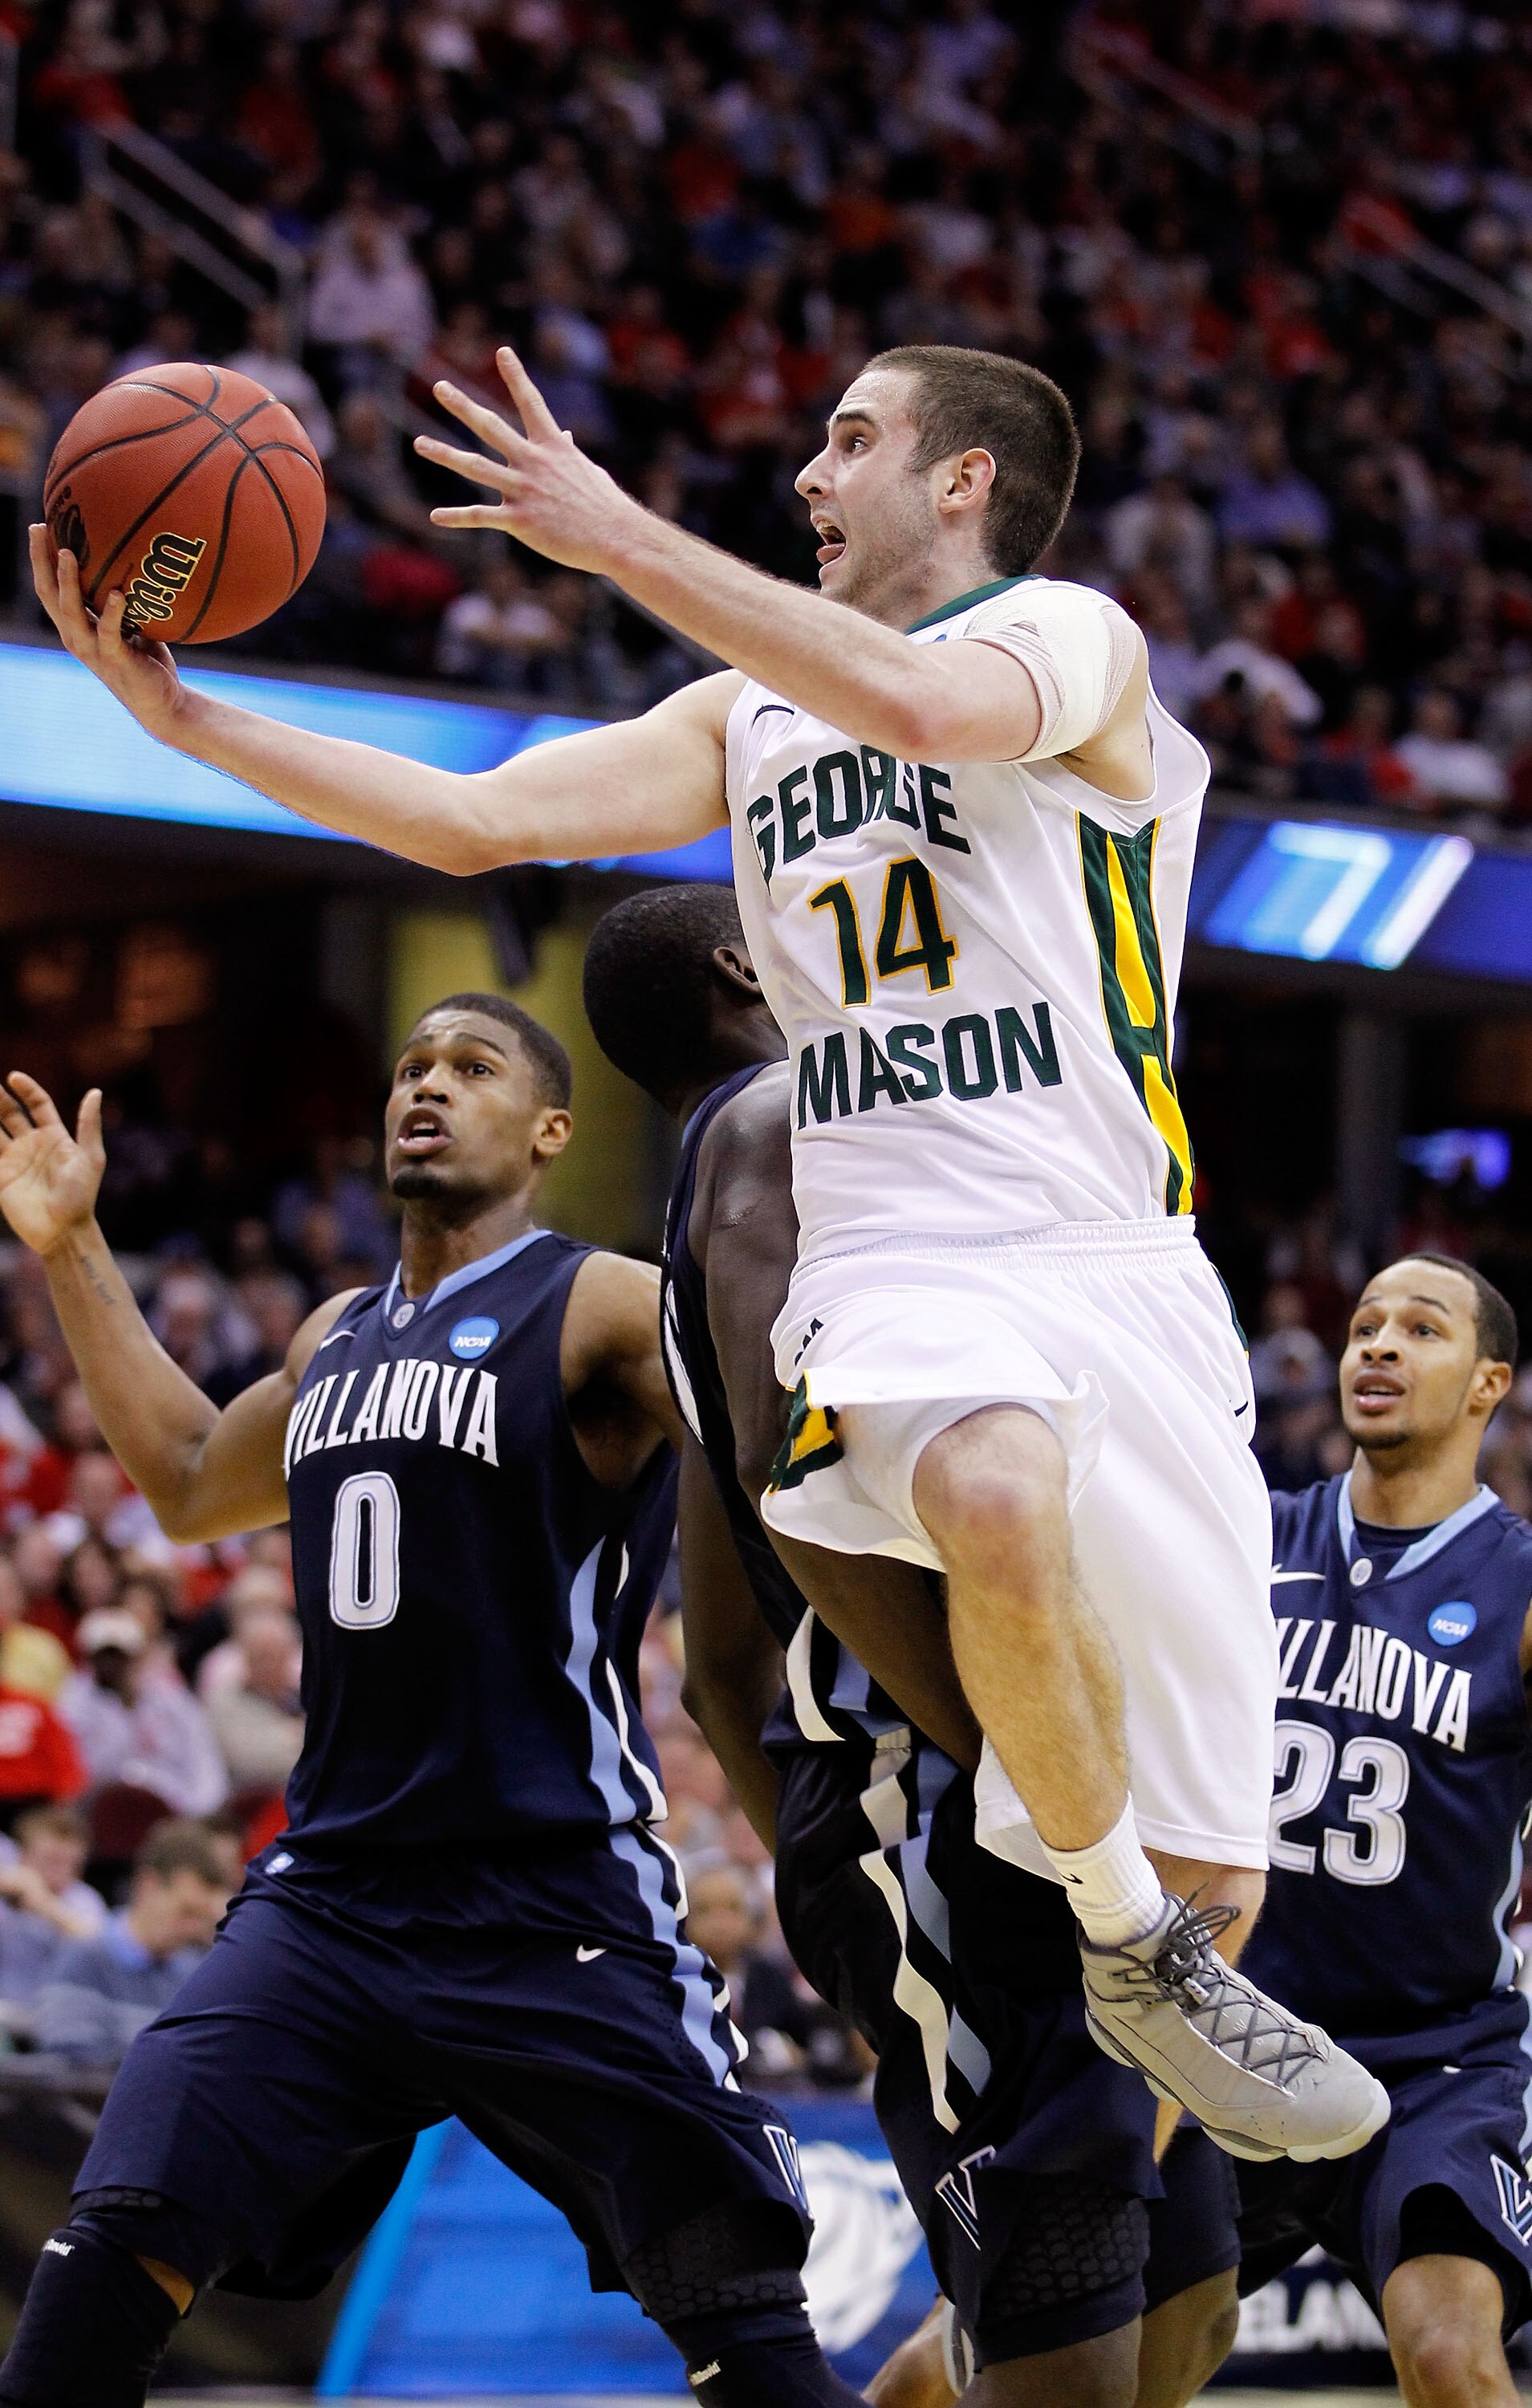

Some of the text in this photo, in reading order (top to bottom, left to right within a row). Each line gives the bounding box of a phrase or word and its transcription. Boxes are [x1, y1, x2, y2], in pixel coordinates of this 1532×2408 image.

[807, 856, 961, 1009] 14
[797, 1001, 1063, 1130] MASON
[453, 1336, 492, 1348] NCAA
[283, 1358, 500, 1483] VILLANOVA
[328, 1470, 400, 1630] 0
[1275, 1617, 1473, 1754] LLANOVA
[1432, 1617, 1469, 1637] NCAA
[1268, 1719, 1410, 1887] 23
